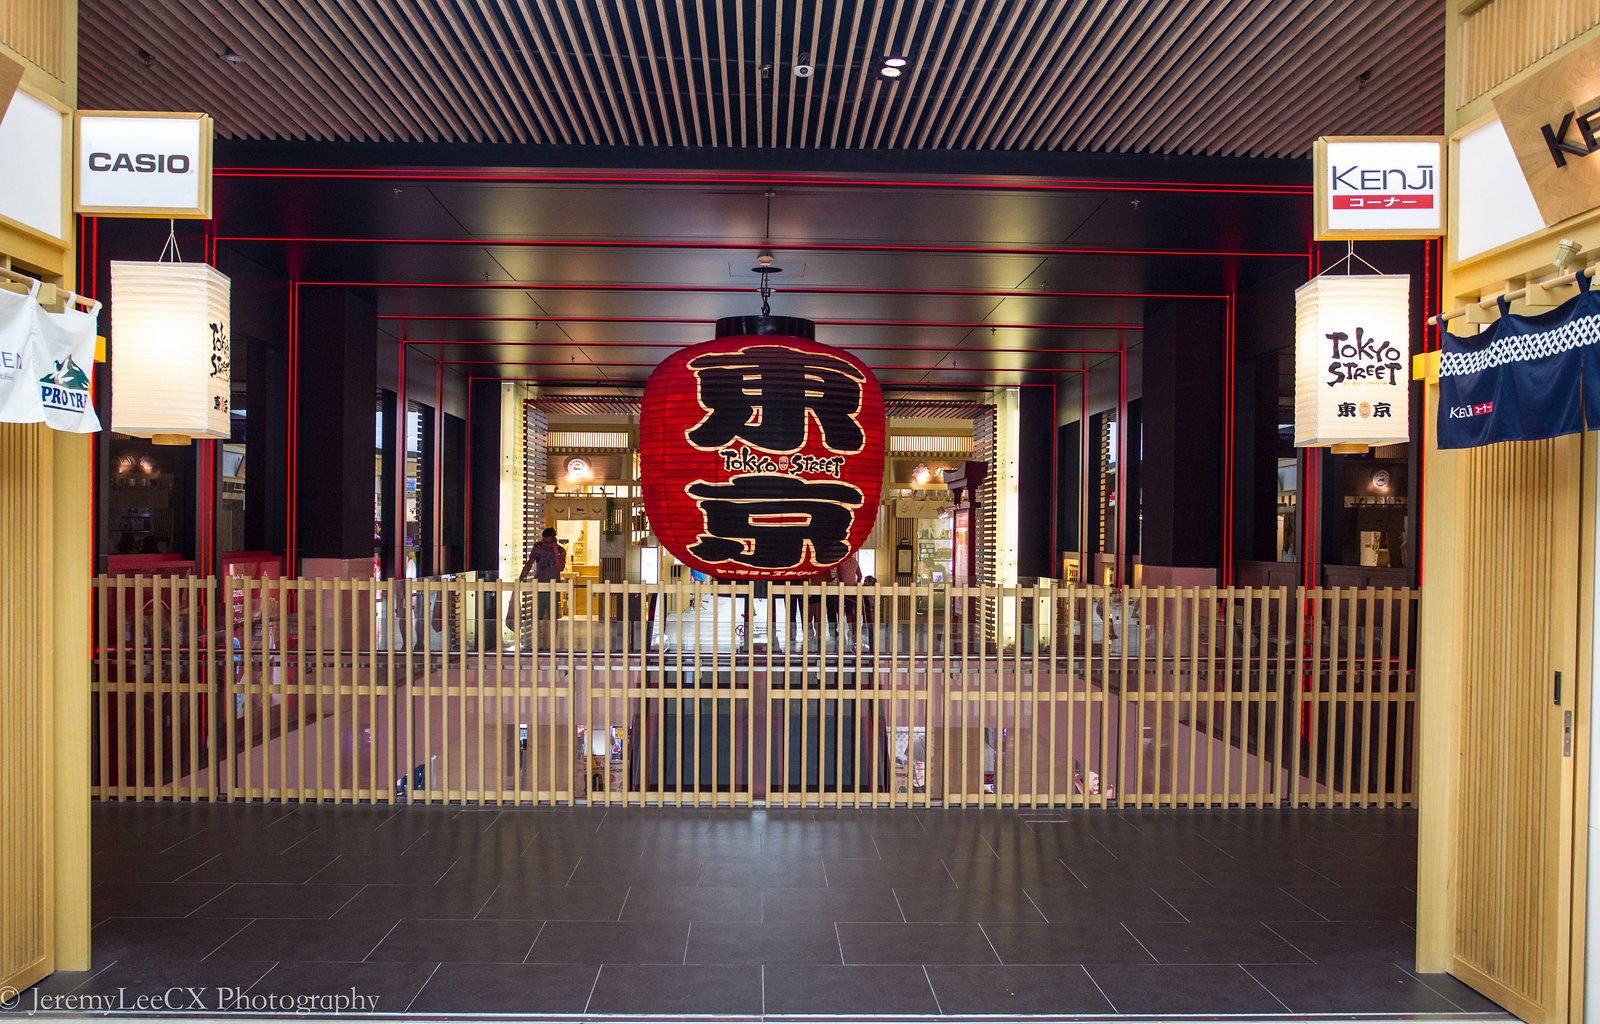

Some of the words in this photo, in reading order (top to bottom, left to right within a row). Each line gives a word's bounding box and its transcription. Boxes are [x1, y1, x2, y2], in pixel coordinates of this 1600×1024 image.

[88, 152, 190, 174] CASIO
[1349, 196, 1417, 207] コーナー
[1326, 361, 1403, 388] STREET
[788, 453, 846, 478] STREET
